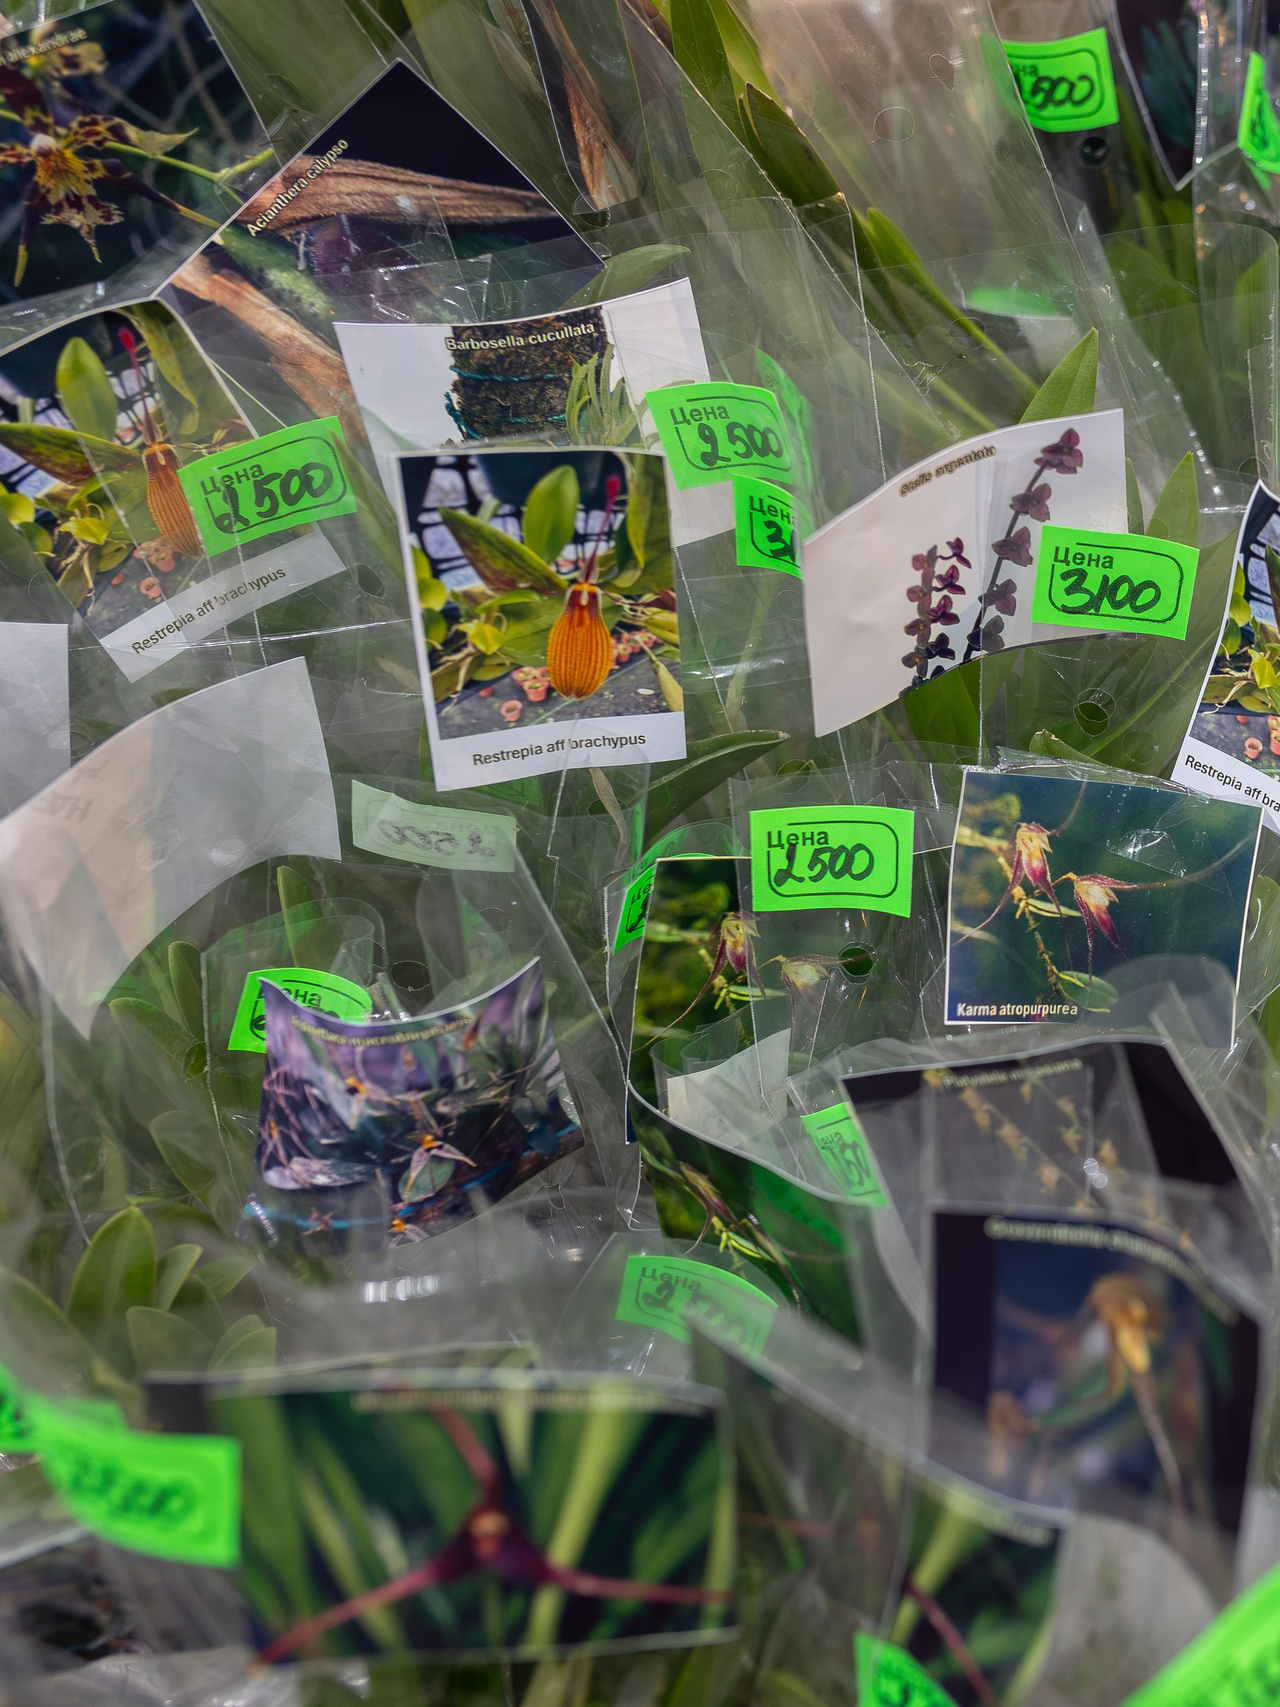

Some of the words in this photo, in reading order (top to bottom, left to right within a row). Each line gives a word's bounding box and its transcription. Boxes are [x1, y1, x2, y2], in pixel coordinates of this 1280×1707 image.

[247, 177, 309, 237] Acianthera
[306, 139, 349, 179] calypso
[446, 334, 525, 350] Barbosella
[528, 322, 595, 344] cucullata
[669, 404, 730, 426] Цена
[697, 422, 784, 466] 2500
[200, 463, 265, 496] Цена
[1053, 546, 1114, 570] Цена
[1060, 567, 1162, 614] 3100
[131, 612, 196, 654] Restrepia
[196, 597, 216, 617] aff
[473, 745, 543, 766] Restrepia
[547, 739, 565, 753] aff
[569, 733, 646, 750] brachypus
[1185, 754, 1243, 791] Restrepia
[1244, 785, 1262, 801] aff
[767, 830, 830, 849] Цена
[772, 843, 875, 887] 2500
[957, 1003, 996, 1017] Karma
[999, 1003, 1078, 1018] atropurpurea
[641, 1266, 701, 1291] Цена
